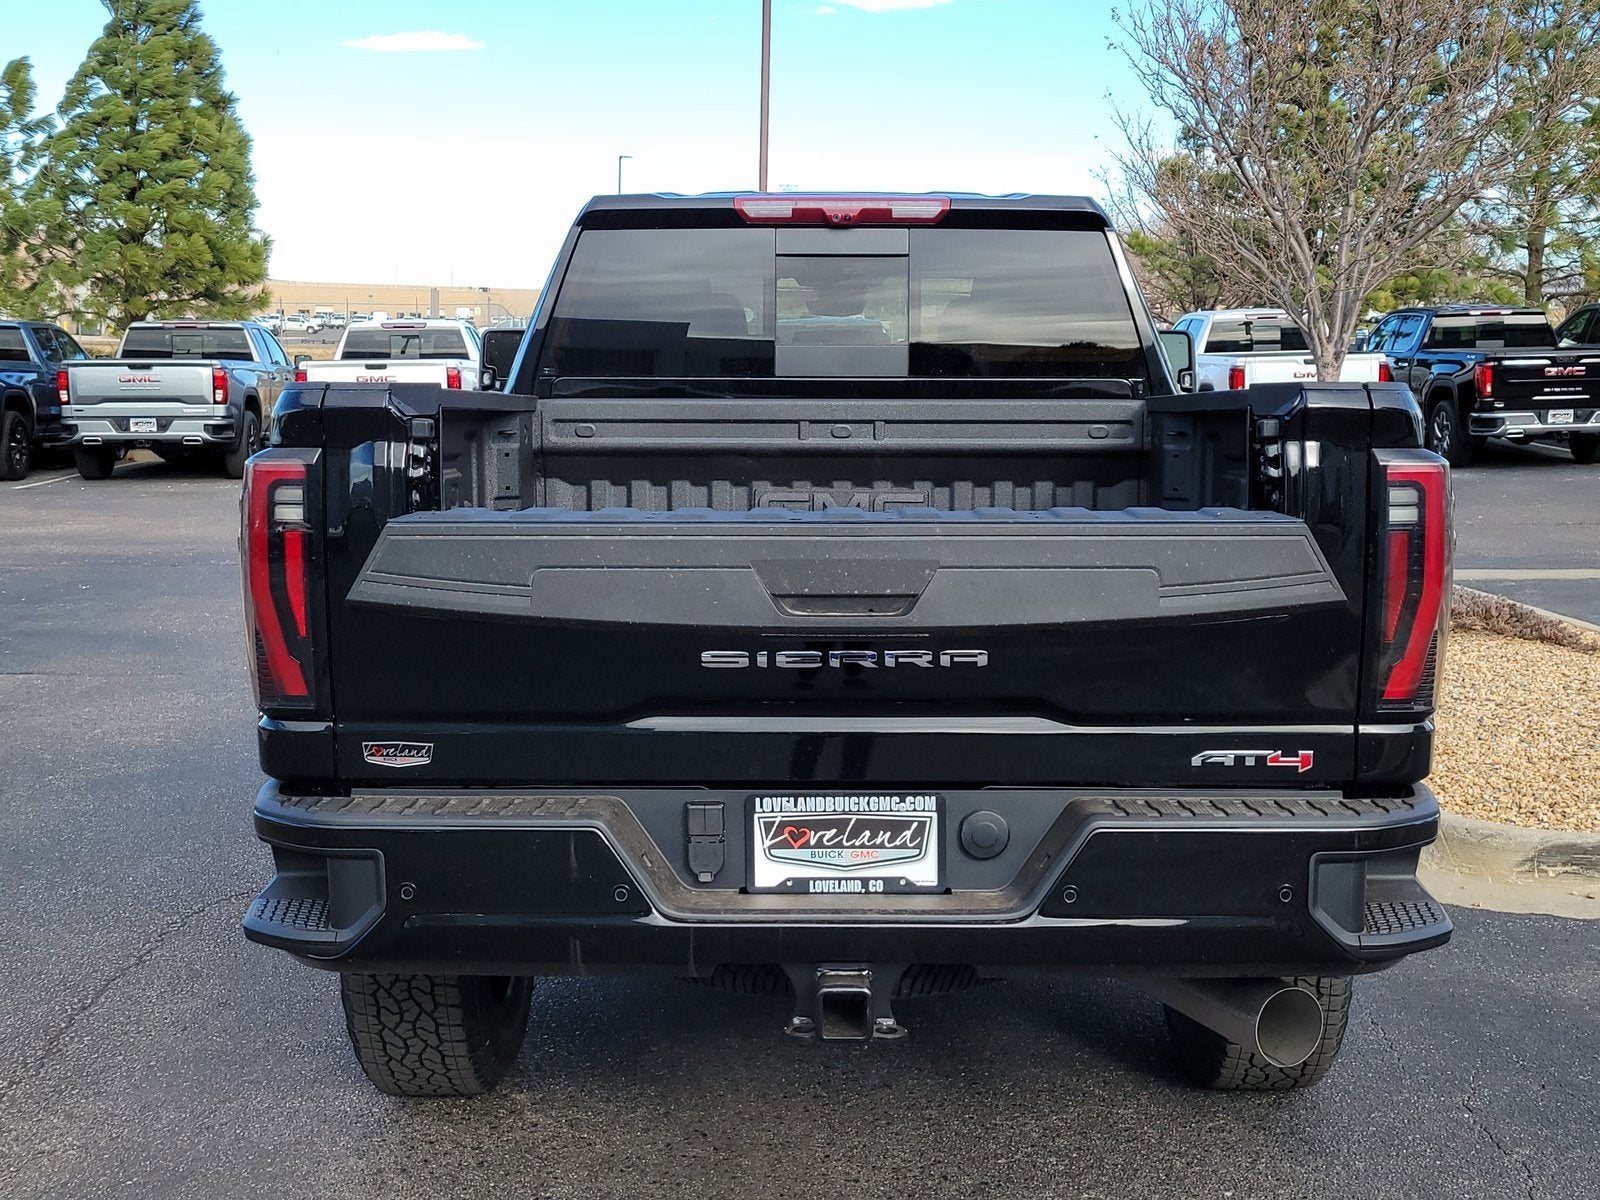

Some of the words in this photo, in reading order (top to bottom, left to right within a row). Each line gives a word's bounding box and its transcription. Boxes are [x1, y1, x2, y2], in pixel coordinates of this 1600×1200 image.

[1293, 371, 1317, 379] GM
[1544, 366, 1586, 376] GMC
[118, 374, 161, 384] GMC
[356, 375, 397, 383] GMC
[700, 650, 989, 669] SIERRA
[1191, 750, 1314, 773] AT4
[755, 796, 936, 812] LOVELANDBUICKGMCCOM
[810, 850, 844, 859] BUICK
[850, 850, 880, 859] GMC
[809, 880, 865, 894] LOVELAND,
[869, 880, 884, 893] CO
